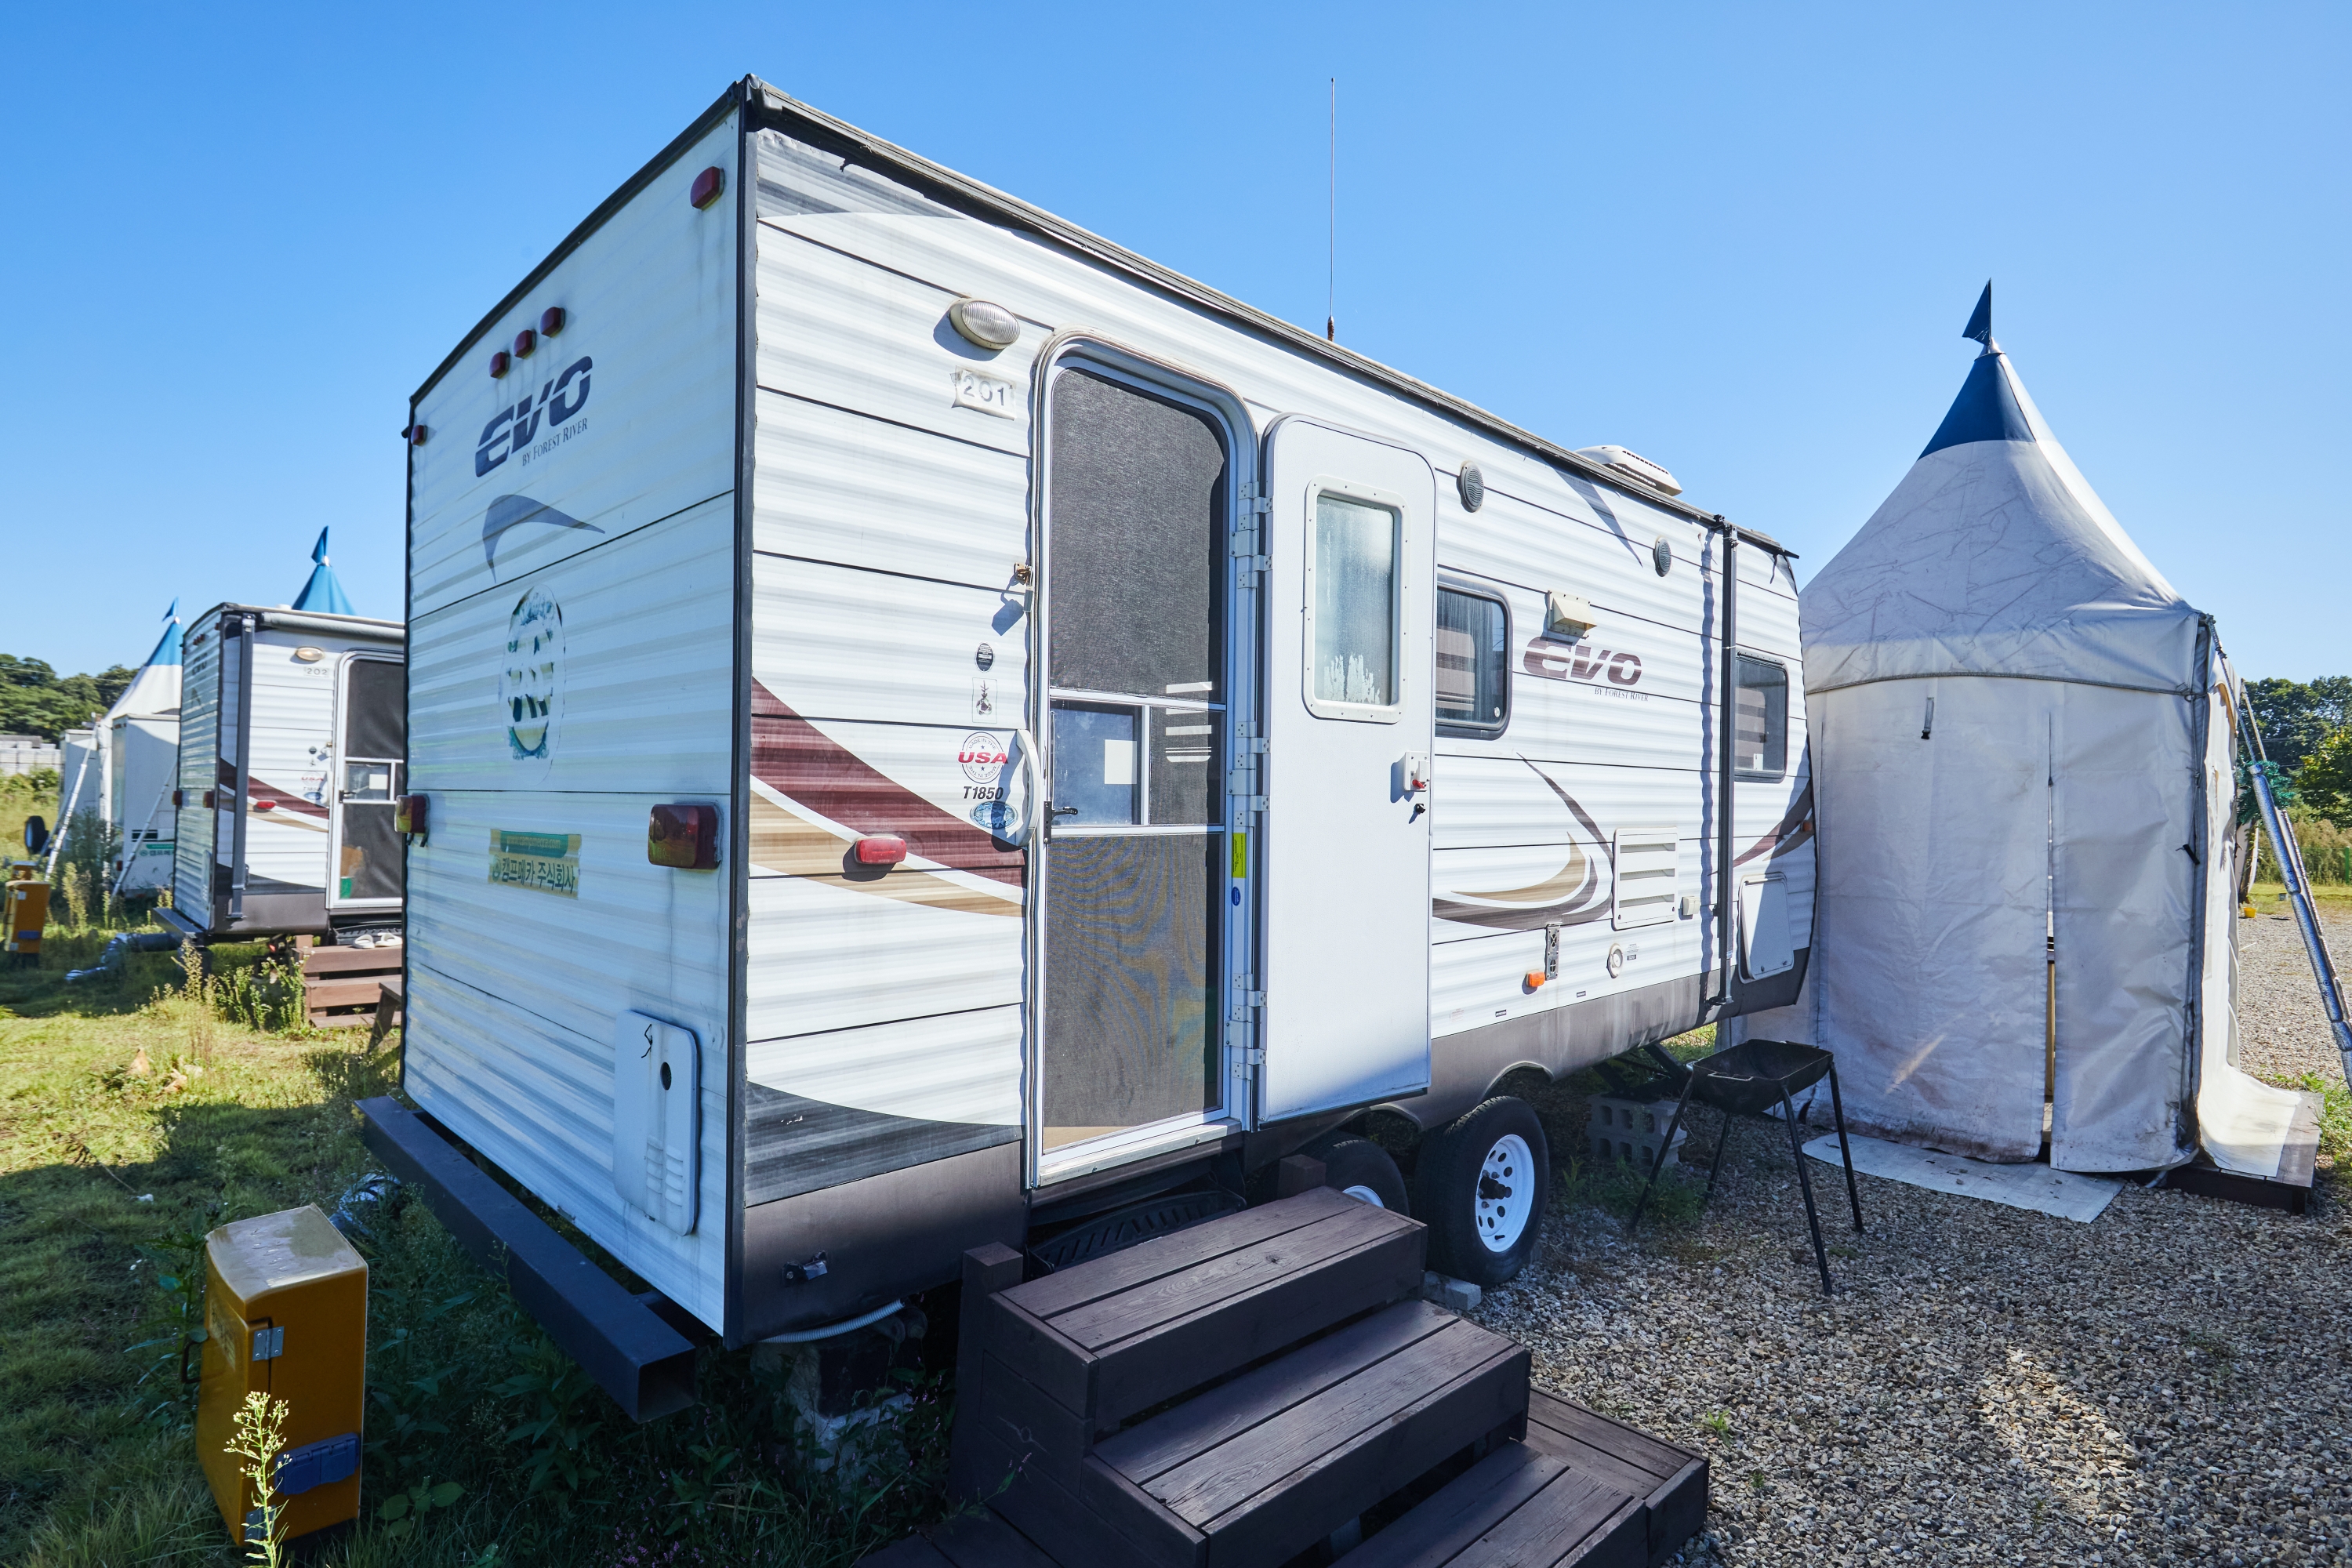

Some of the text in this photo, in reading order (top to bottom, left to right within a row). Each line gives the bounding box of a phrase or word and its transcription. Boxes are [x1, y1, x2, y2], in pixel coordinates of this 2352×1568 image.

[963, 375, 1004, 406] 201
[475, 356, 593, 477] EVO
[522, 417, 588, 466] BY FOREST RIVER
[307, 667, 328, 676] 202
[1523, 636, 1642, 686] EVO
[1595, 687, 1649, 702] BY FOREST RIVER
[968, 738, 981, 750] MADE
[988, 740, 996, 750] THE
[958, 751, 1008, 764] USA
[963, 786, 1004, 800] T1850
[502, 857, 575, 895] 캠프메카 주식회사
